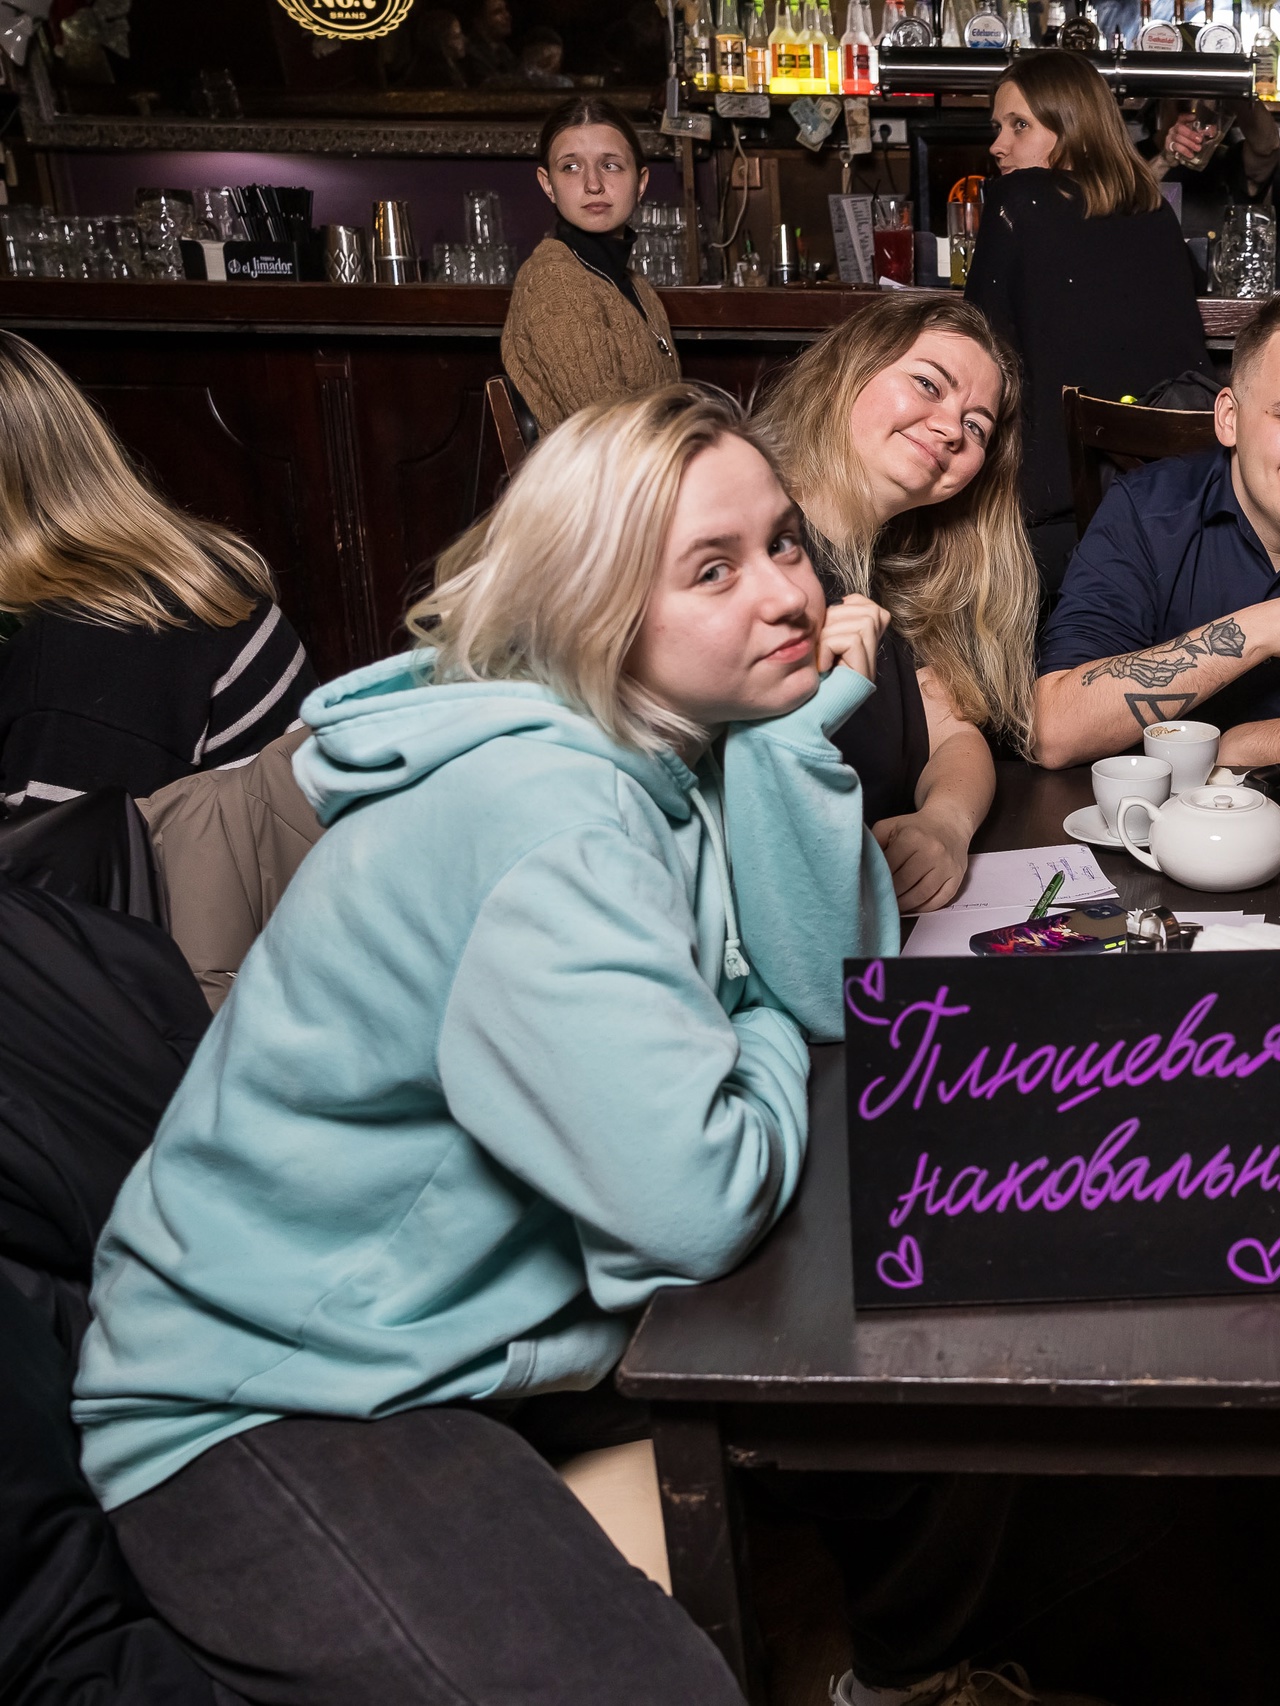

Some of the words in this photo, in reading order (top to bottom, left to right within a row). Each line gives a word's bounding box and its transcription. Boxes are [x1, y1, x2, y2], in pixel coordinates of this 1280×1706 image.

[329, 11, 367, 20] BRAND
[242, 261, 251, 274] el
[251, 256, 293, 278] Jimador
